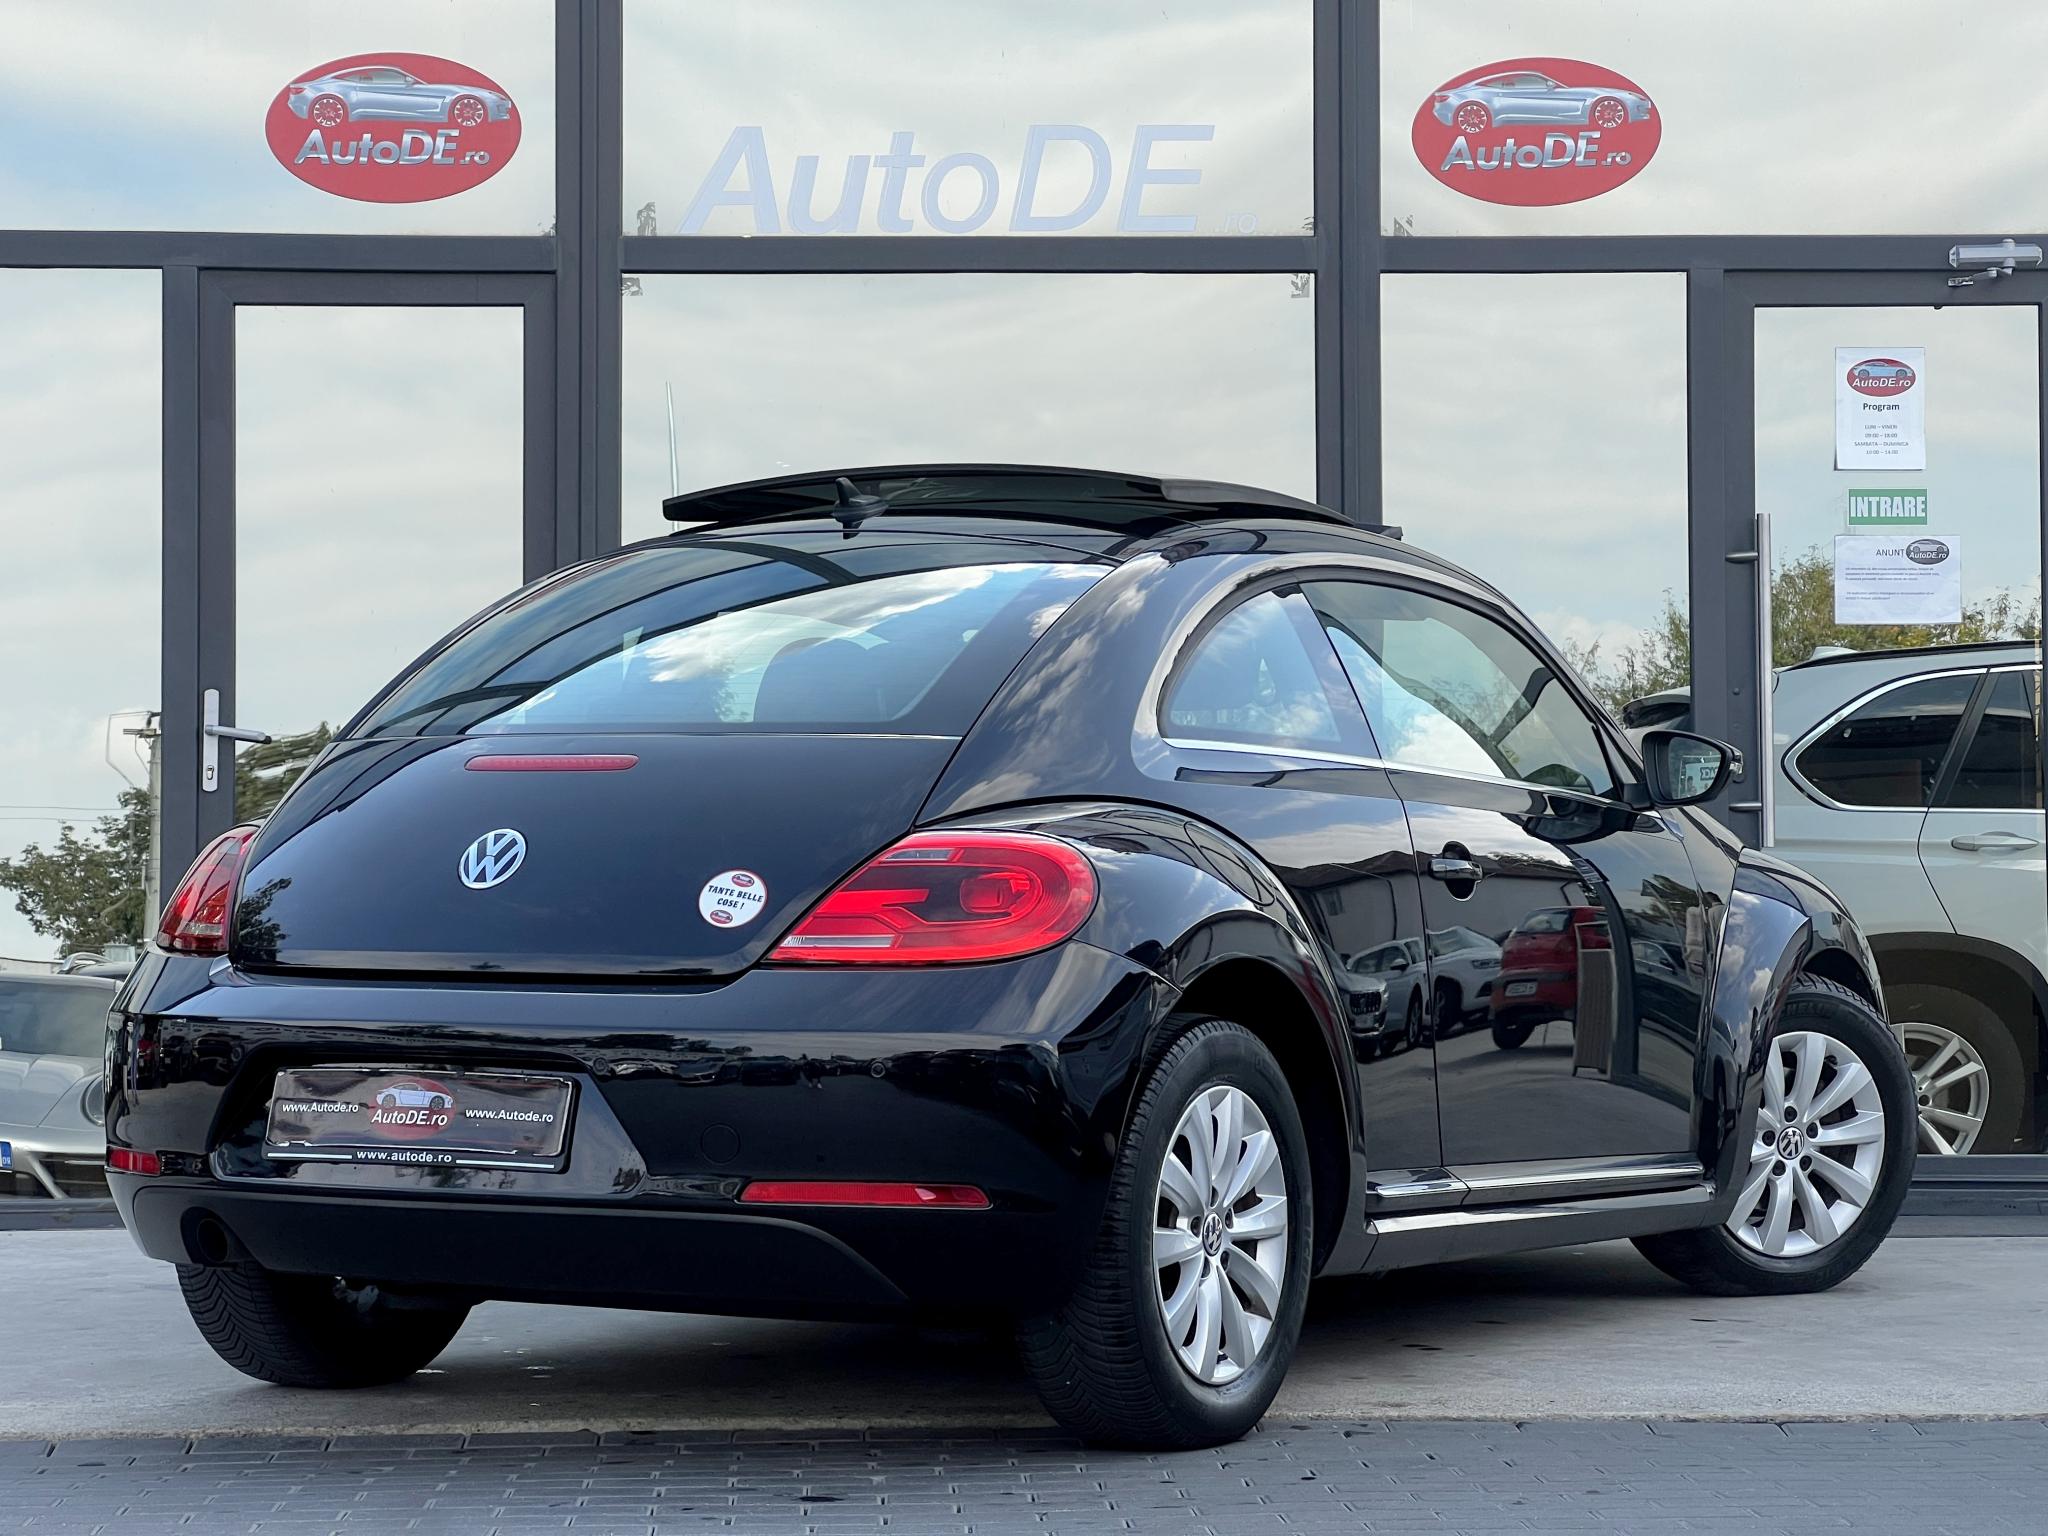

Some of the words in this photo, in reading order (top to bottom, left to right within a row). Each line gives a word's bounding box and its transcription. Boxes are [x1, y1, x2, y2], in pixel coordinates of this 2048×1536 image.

[1852, 377, 1911, 388] AutoDE.ro
[1862, 403, 1900, 412] Program
[1850, 496, 1926, 518] INTRARE
[708, 885, 735, 896] TANTE
[736, 890, 764, 903] BELLE
[717, 897, 739, 908] COSE
[282, 1102, 359, 1113] www.Autode.ro
[371, 1108, 448, 1126] AutoDE.ro
[465, 1109, 554, 1123] www.Autode.ro
[356, 1151, 452, 1163] www.autode.ro
